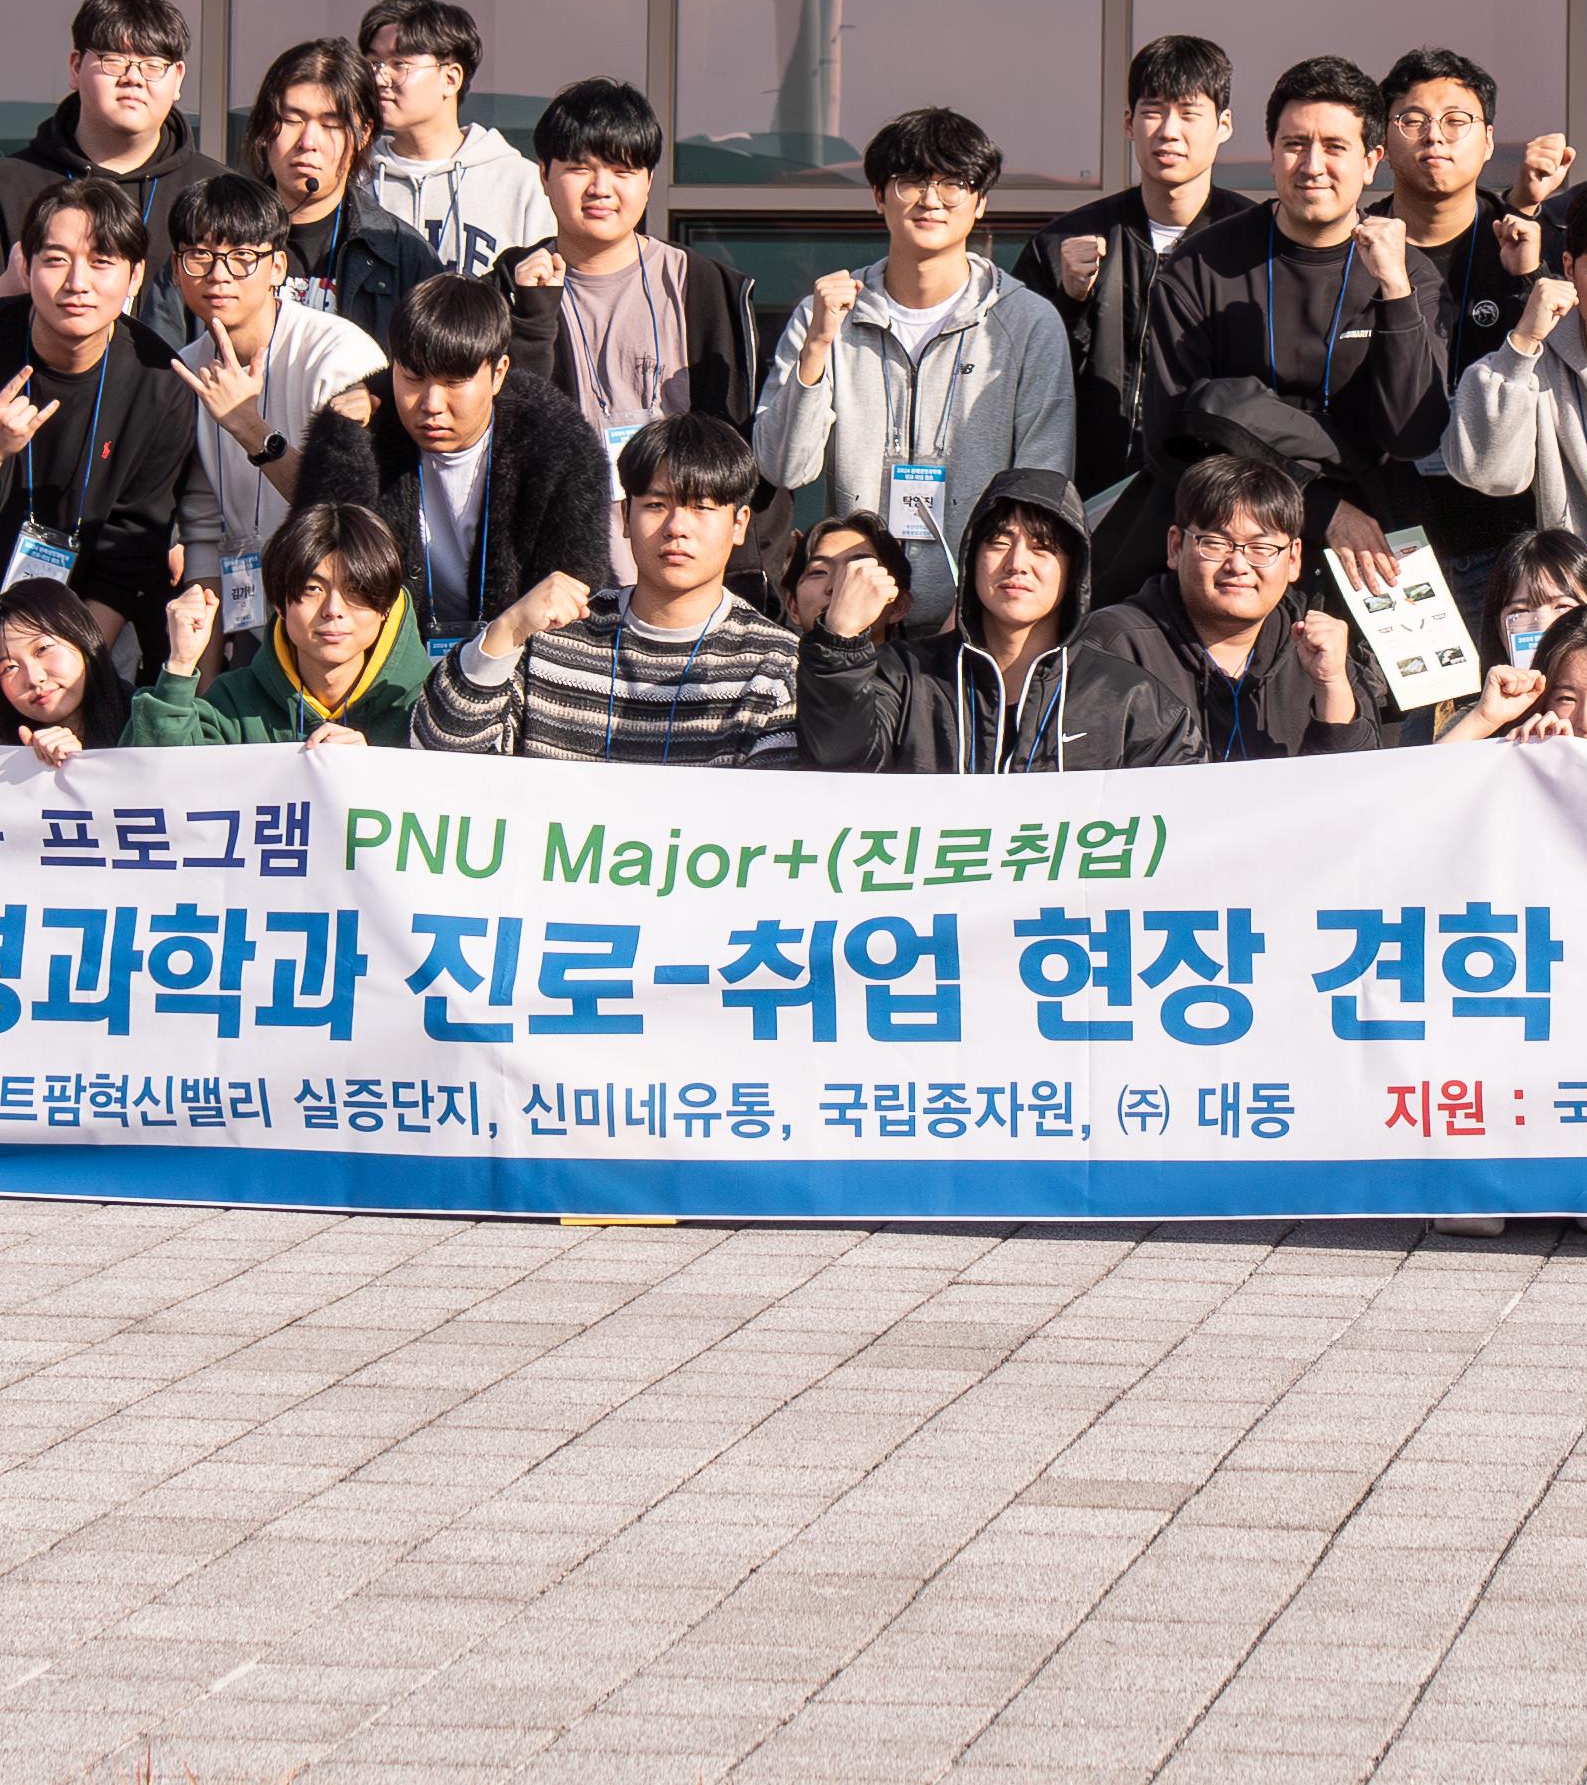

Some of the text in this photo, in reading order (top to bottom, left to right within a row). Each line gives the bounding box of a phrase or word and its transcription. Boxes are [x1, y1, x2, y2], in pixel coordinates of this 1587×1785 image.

[41, 802, 311, 877] 프로그램
[346, 810, 506, 880] PNU
[543, 816, 1168, 898] Major+(진로취업)
[405, 912, 963, 1045] 진로-취업
[1013, 907, 1266, 1046] 현장
[1312, 902, 1565, 1043] 견학
[294, 1078, 499, 1139] 실증단지,
[522, 1082, 793, 1142] 신미네유통,
[819, 1079, 1093, 1142] 국립종자원,
[1198, 1082, 1296, 1140] 대동
[1384, 1079, 1488, 1139] 지원
